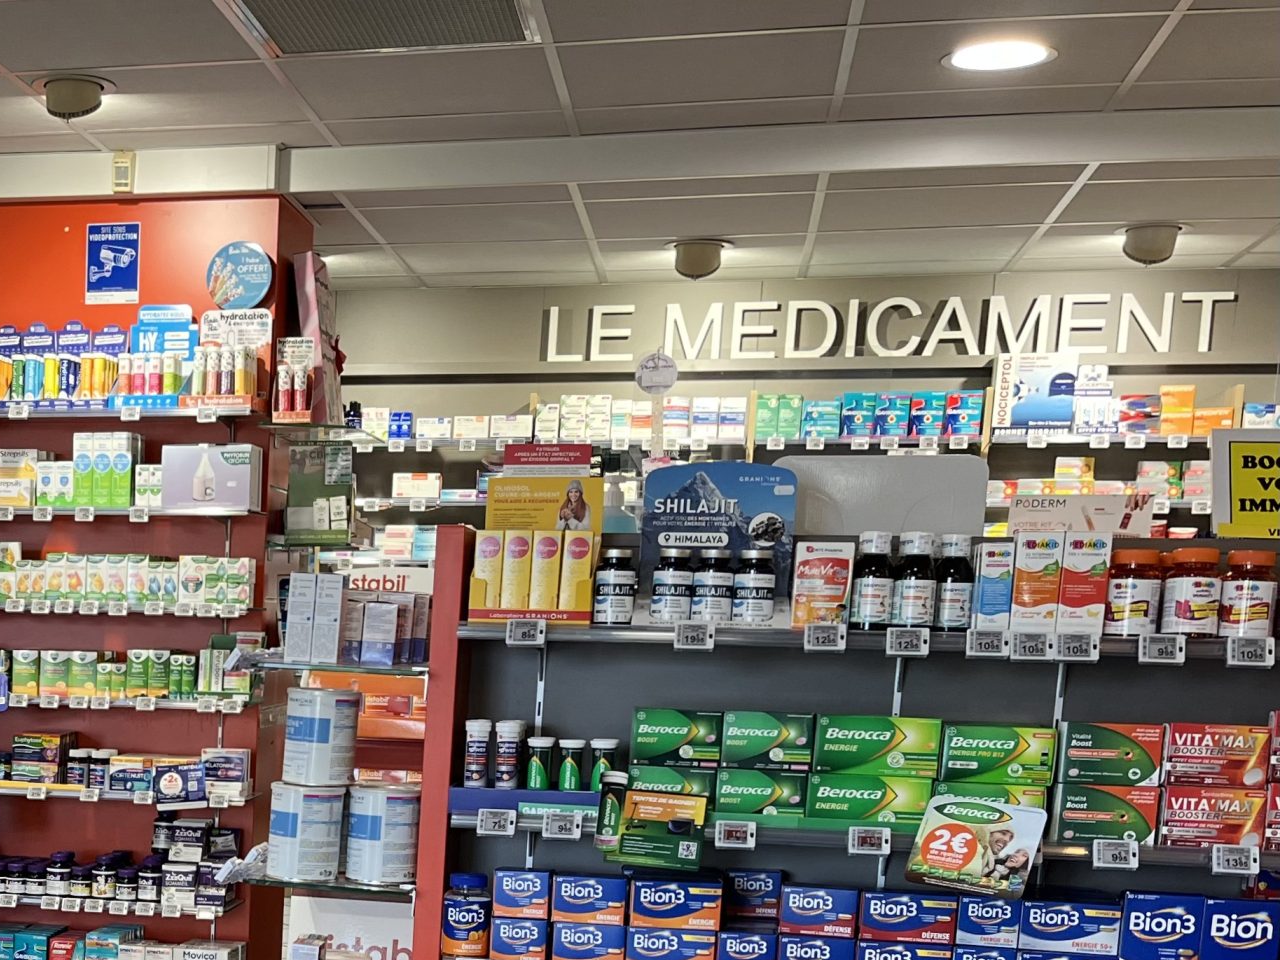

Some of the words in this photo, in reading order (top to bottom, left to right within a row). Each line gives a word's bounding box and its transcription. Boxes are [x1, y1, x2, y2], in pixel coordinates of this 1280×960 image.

[237, 264, 269, 273] OFFERT
[220, 311, 269, 323] hydratation
[547, 304, 635, 362] LE
[662, 291, 1235, 360] MEDICAMENT
[998, 355, 1012, 426] NOCICEPTOL
[0, 449, 29, 459] Strepsils
[654, 498, 738, 515] SHILAJIT
[674, 534, 724, 545] HIMALAYA
[599, 585, 630, 596] SHILAJIT
[655, 585, 686, 596] SHILAJIT
[695, 585, 728, 597] SHILAJIT
[736, 588, 768, 599] SHILAJIT
[638, 723, 689, 736] Berocca
[727, 726, 779, 738] Berocca
[825, 727, 892, 741] Berocca
[637, 736, 658, 744] BOOST
[726, 738, 748, 747] BOOST
[950, 737, 1015, 750] Berocca
[1071, 739, 1093, 748] Boost
[1220, 734, 1256, 749] MAX
[824, 743, 858, 752] ENERGIE
[1173, 746, 1224, 757] BOOSTER
[817, 785, 883, 799] Berocca
[815, 801, 850, 811] ENERGIE
[1216, 799, 1253, 813] MAX
[943, 804, 1002, 822] Berocca
[1169, 810, 1220, 821] BOOSTER
[929, 829, 973, 854] 2€
[502, 876, 541, 892] Bion3
[560, 881, 603, 899] Bion3
[640, 887, 685, 904] Bion3
[789, 893, 833, 910] Bion3
[870, 898, 918, 917] Bion3
[968, 903, 1012, 919] Bion3
[448, 907, 485, 923] Bion3
[1029, 907, 1080, 926] Bion3
[1128, 911, 1196, 934] Bion3
[1210, 914, 1274, 939] Bion
[823, 925, 852, 934] DÉFENSE
[921, 930, 950, 940] DÉFENSE
[183, 950, 218, 960] Movicol
